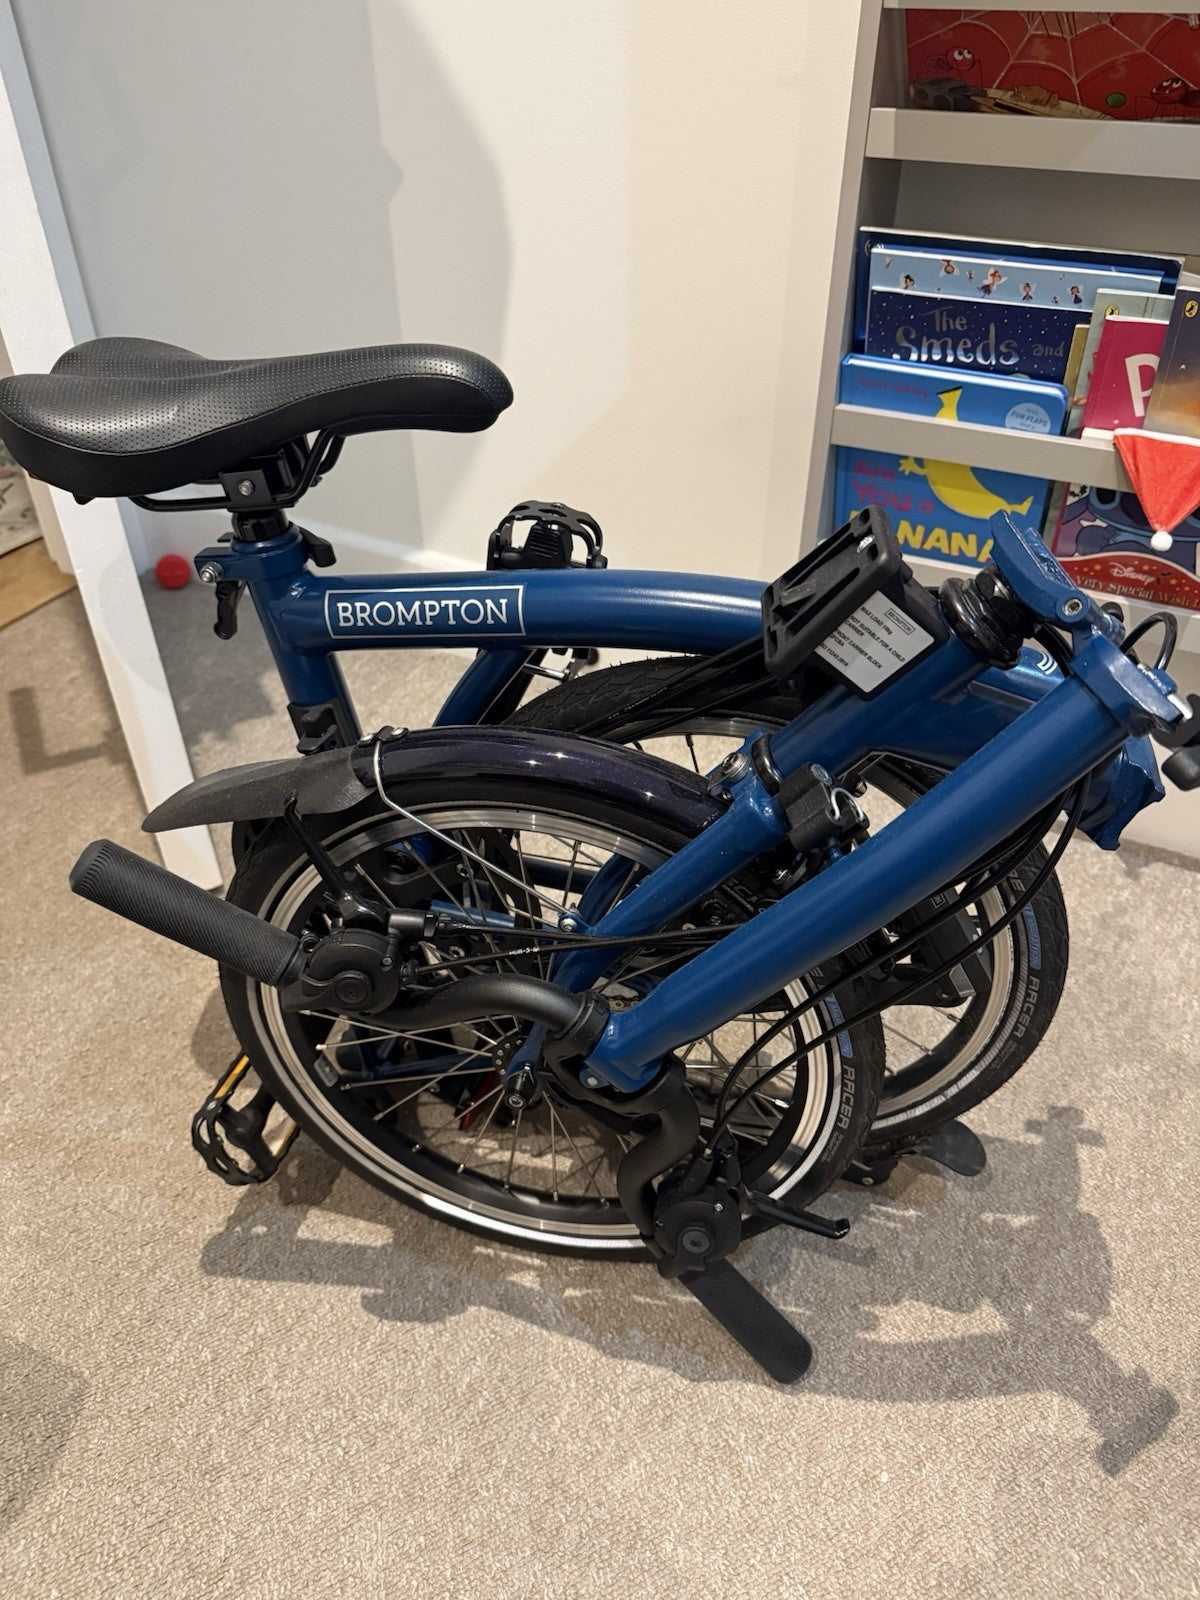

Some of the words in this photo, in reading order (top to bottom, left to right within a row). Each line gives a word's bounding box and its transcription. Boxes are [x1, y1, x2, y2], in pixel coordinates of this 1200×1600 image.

[921, 306, 968, 332] The
[892, 322, 1020, 366] Smeds
[1031, 341, 1066, 358] and
[1010, 410, 1026, 421] FUN
[1025, 415, 1047, 428] FLAPS
[853, 460, 897, 483] Are
[1076, 575, 1104, 591] Very
[1107, 583, 1154, 600] Special
[1109, 562, 1156, 586] Disney
[336, 598, 508, 627] BROMPTON
[860, 606, 872, 617] MAX
[870, 614, 884, 627] LOAD
[848, 640, 868, 657] CARRIER
[866, 655, 884, 669] BLOCK
[860, 623, 881, 642] SUITABLE
[879, 639, 890, 649] FOR
[891, 650, 906, 662] CHILD
[1013, 975, 1040, 1038] RACER
[836, 1065, 857, 1130] RACER
